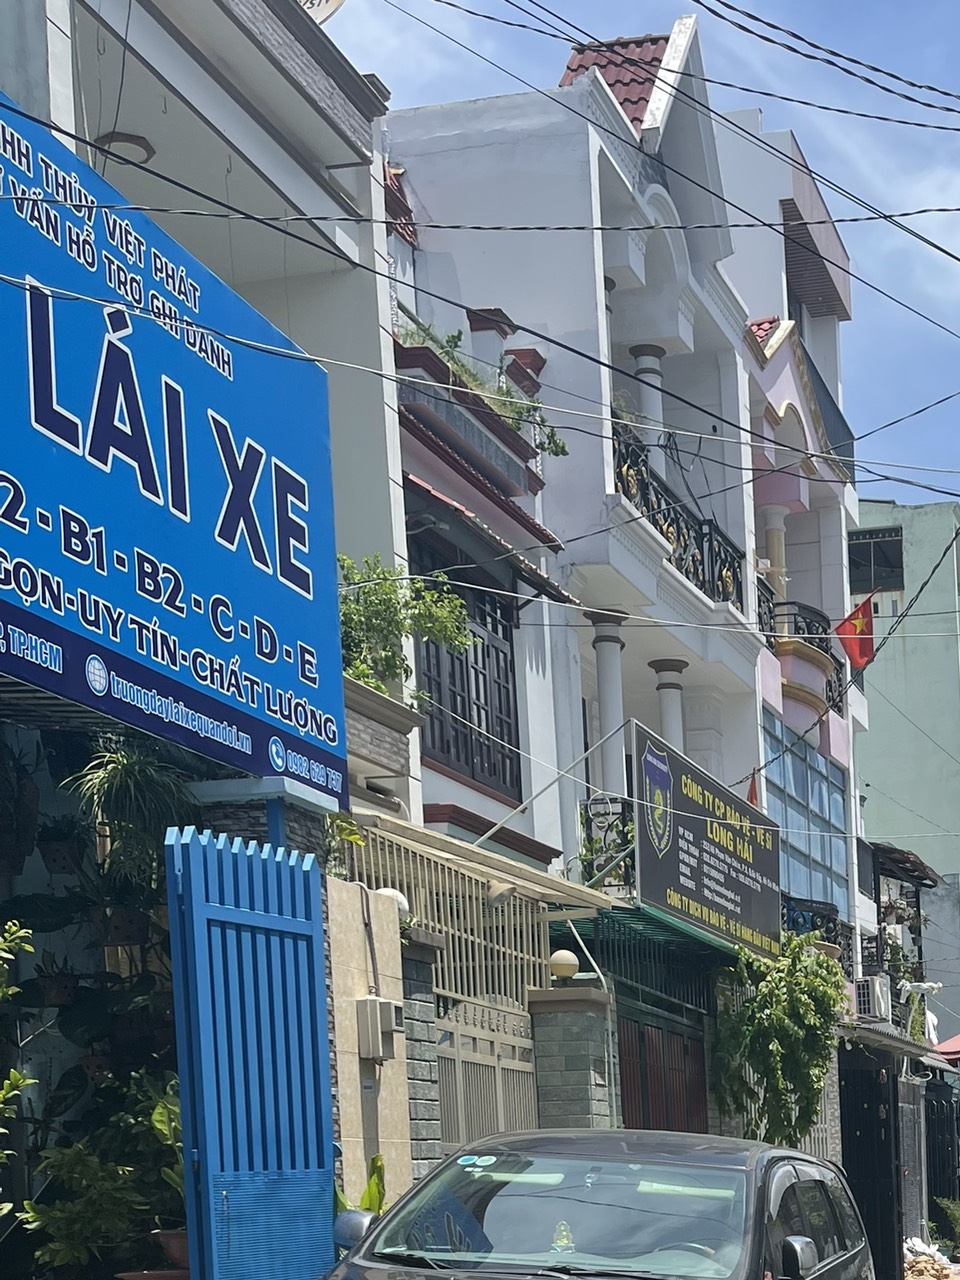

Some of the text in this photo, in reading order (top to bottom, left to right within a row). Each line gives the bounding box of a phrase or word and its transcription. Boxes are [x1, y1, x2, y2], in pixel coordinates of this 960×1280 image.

[38, 152, 97, 226] THỦY
[102, 208, 146, 268] VIỆT
[151, 247, 200, 313] PHÁT
[66, 220, 97, 272] HỖ
[102, 250, 144, 313] TRỢ
[149, 290, 181, 340] GHI
[183, 316, 233, 381] DANH
[26, 273, 314, 601] LÁI XE
[59, 504, 107, 577] B1
[134, 547, 186, 618] B2
[210, 594, 234, 642] C
[254, 616, 280, 664] D
[298, 640, 319, 689] E
[8, 624, 63, 674] TP.HCM
[264, 683, 338, 745] LƯỢNG
[681, 773, 703, 806] CÔNG
[703, 789, 714, 812] TY
[714, 797, 725, 819] CP
[726, 804, 741, 830] BẢO
[706, 818, 734, 852] LONG
[736, 836, 753, 864] HẢI
[666, 886, 682, 909] CÔNG
